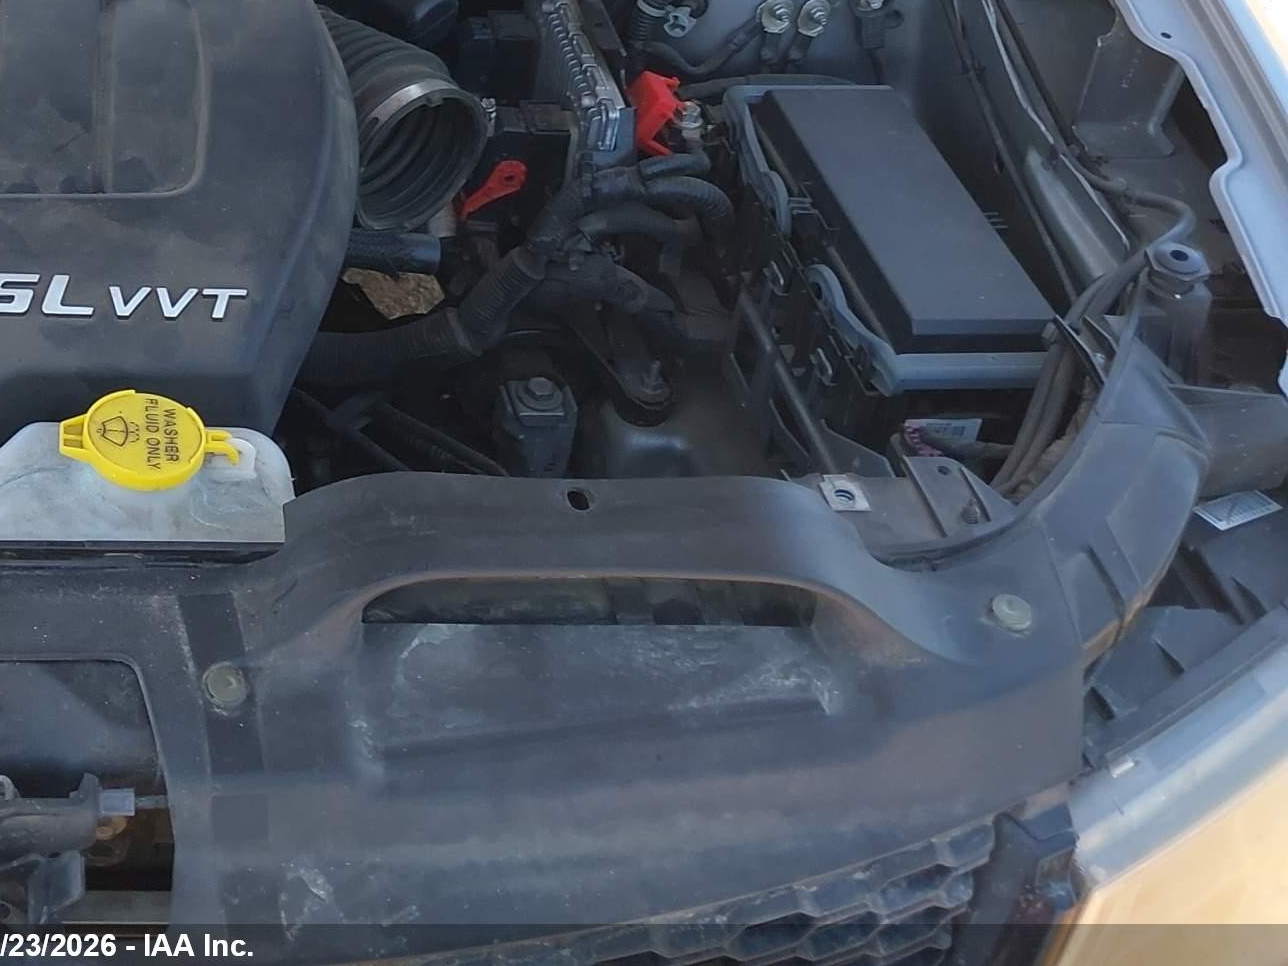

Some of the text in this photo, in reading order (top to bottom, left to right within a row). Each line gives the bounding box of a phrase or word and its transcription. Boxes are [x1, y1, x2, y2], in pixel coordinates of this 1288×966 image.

[108, 286, 249, 320] VVT
[144, 398, 161, 470] FLUID ONLY
[163, 408, 180, 463] WASHER
